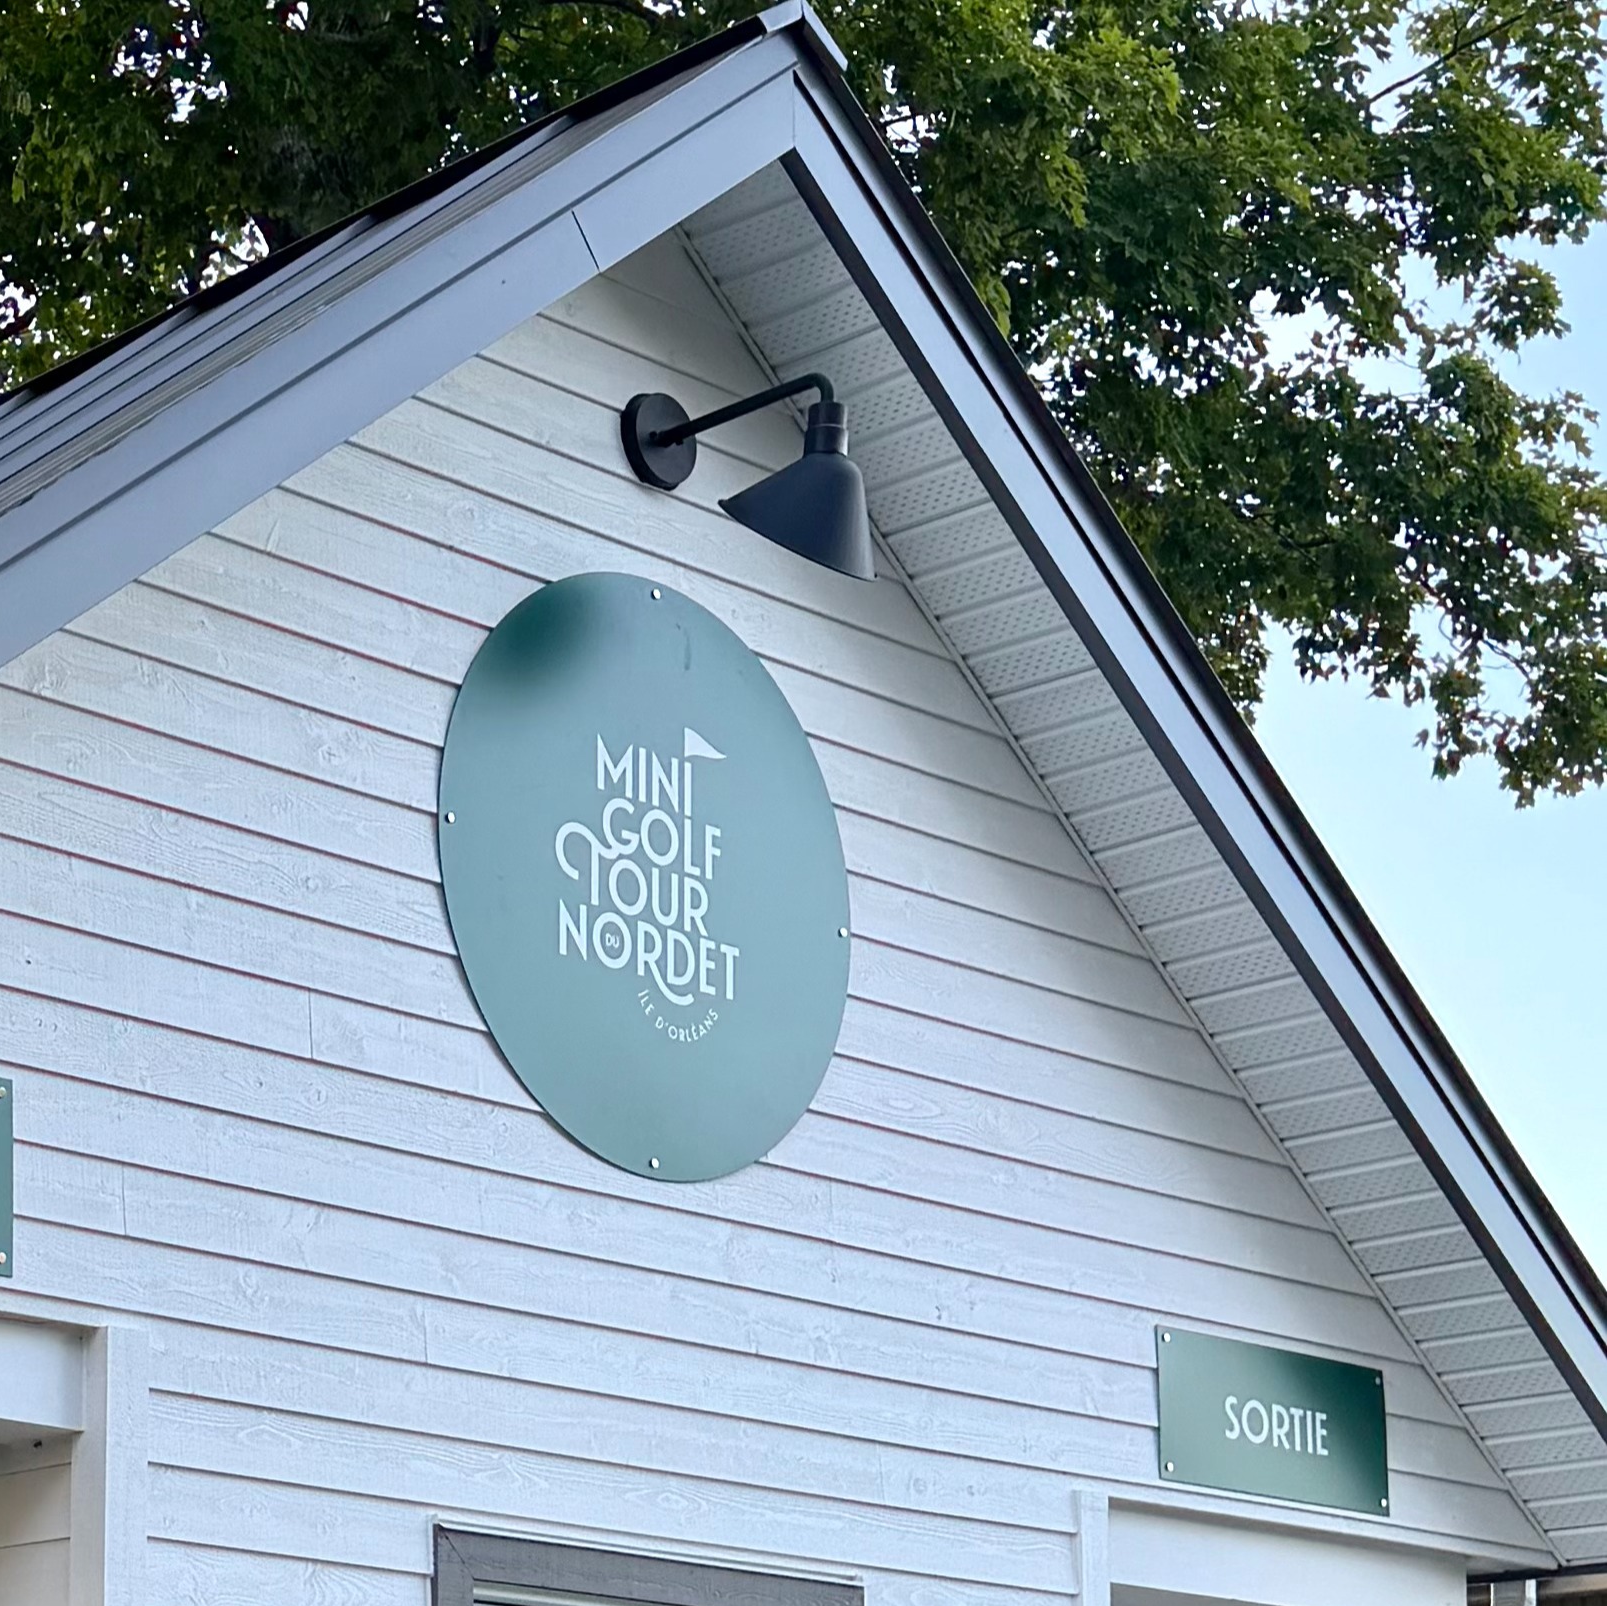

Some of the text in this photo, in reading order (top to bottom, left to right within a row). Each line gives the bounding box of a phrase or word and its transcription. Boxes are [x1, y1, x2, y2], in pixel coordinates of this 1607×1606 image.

[596, 733, 692, 817] MINI
[555, 821, 709, 937] TOUR
[602, 798, 722, 880] GOLF
[558, 899, 741, 1006] NORDET
[605, 933, 620, 948] DU
[655, 1008, 719, 1042] D'ORLÉANS
[1224, 1395, 1329, 1456] SORTIE
